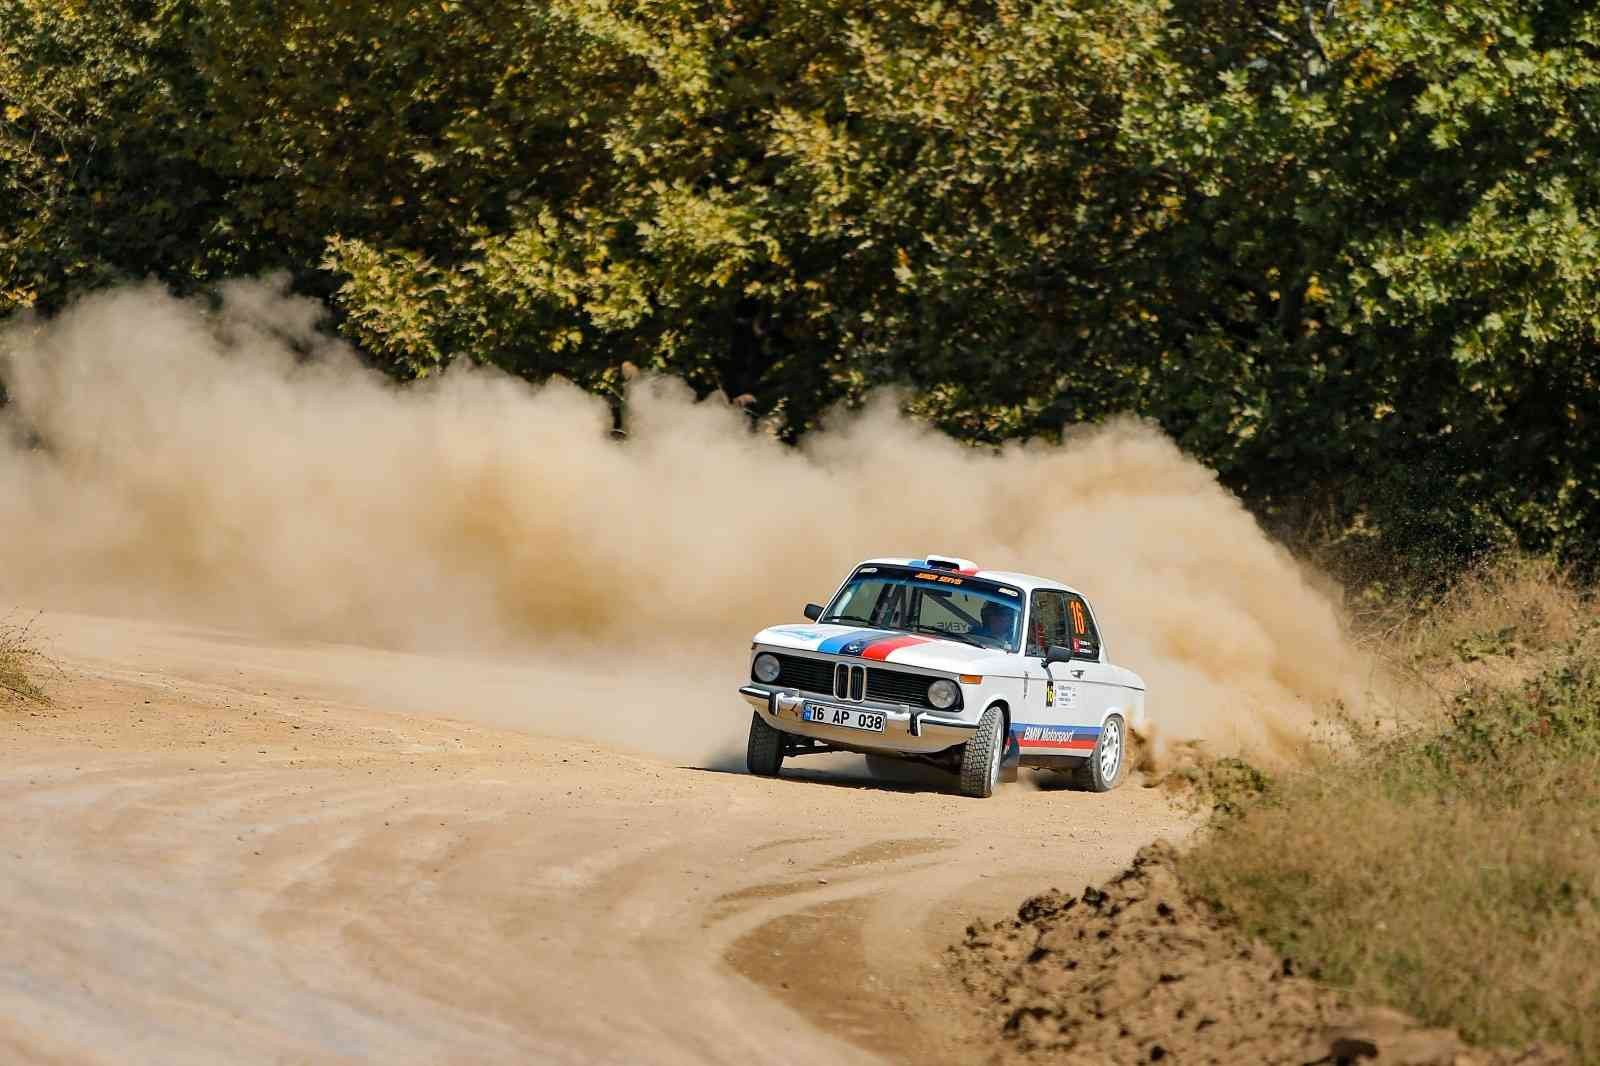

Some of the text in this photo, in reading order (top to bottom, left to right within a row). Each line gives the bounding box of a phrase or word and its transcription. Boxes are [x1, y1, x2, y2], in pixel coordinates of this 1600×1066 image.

[1069, 600, 1085, 635] 16
[812, 706, 825, 721] 16
[832, 710, 850, 725] AP
[858, 714, 883, 729] 038
[1023, 726, 1073, 744] BMW Motorsport
